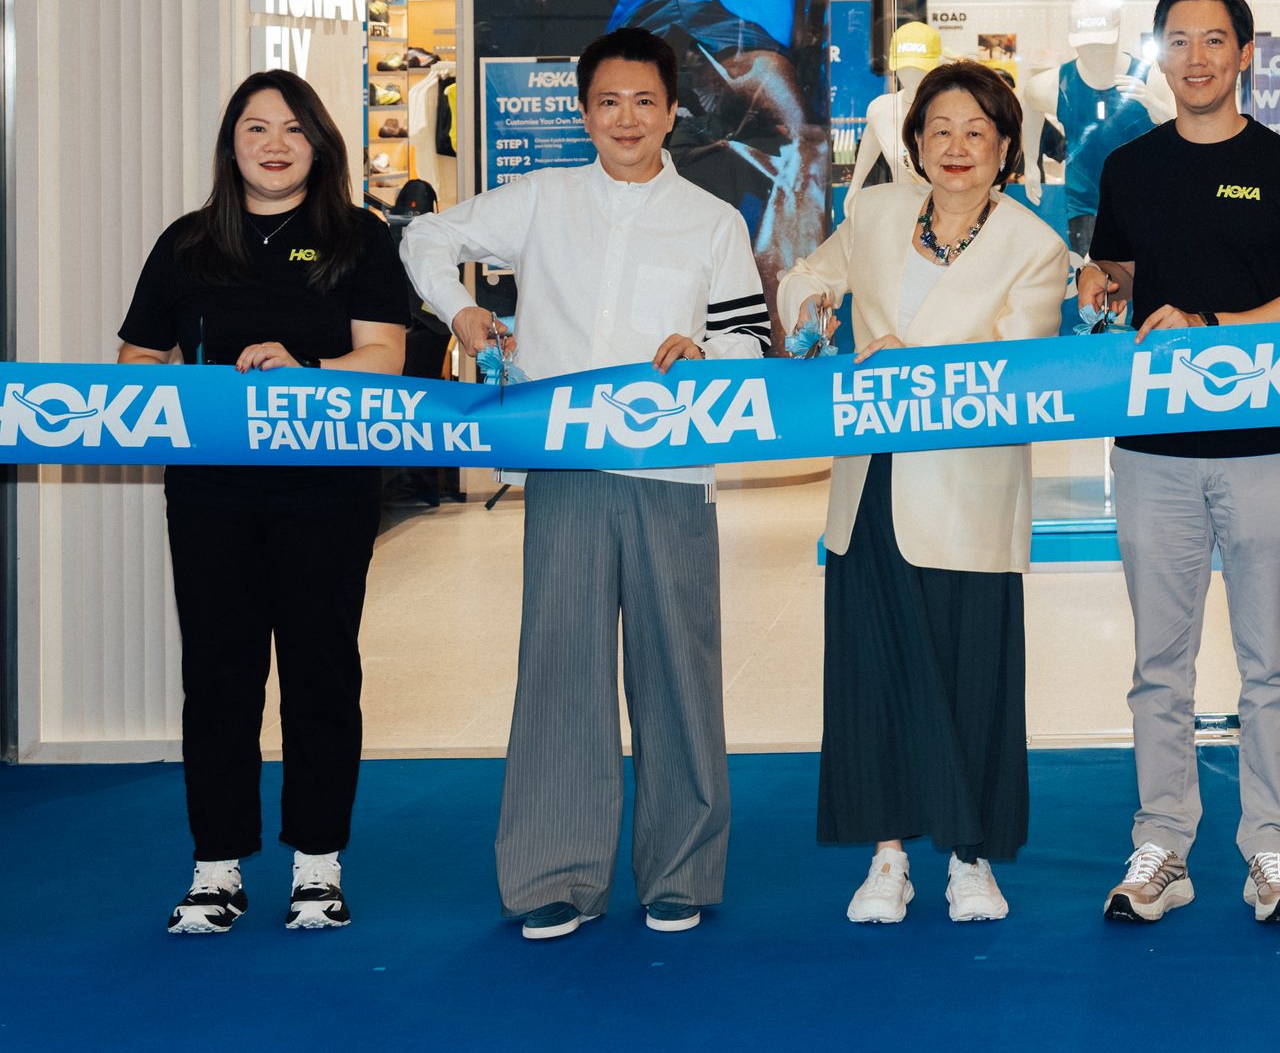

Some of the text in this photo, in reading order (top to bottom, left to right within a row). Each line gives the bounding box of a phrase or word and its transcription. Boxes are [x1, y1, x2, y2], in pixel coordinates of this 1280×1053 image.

[932, 13, 967, 22] ROAD
[528, 71, 578, 88] HOKA
[496, 95, 581, 114] TOTE STU
[496, 138, 522, 150] STEP
[523, 138, 529, 149] 1
[496, 156, 522, 167] STEP
[523, 155, 531, 166] 2
[1216, 184, 1261, 201] HOKA
[289, 249, 317, 262] HO
[832, 359, 1008, 404] LET'S FLY
[247, 385, 427, 420] LET'S FLY
[545, 377, 776, 451] HOKA
[833, 389, 1075, 437] PAVILION KL
[248, 420, 492, 452] PAVILION KL
